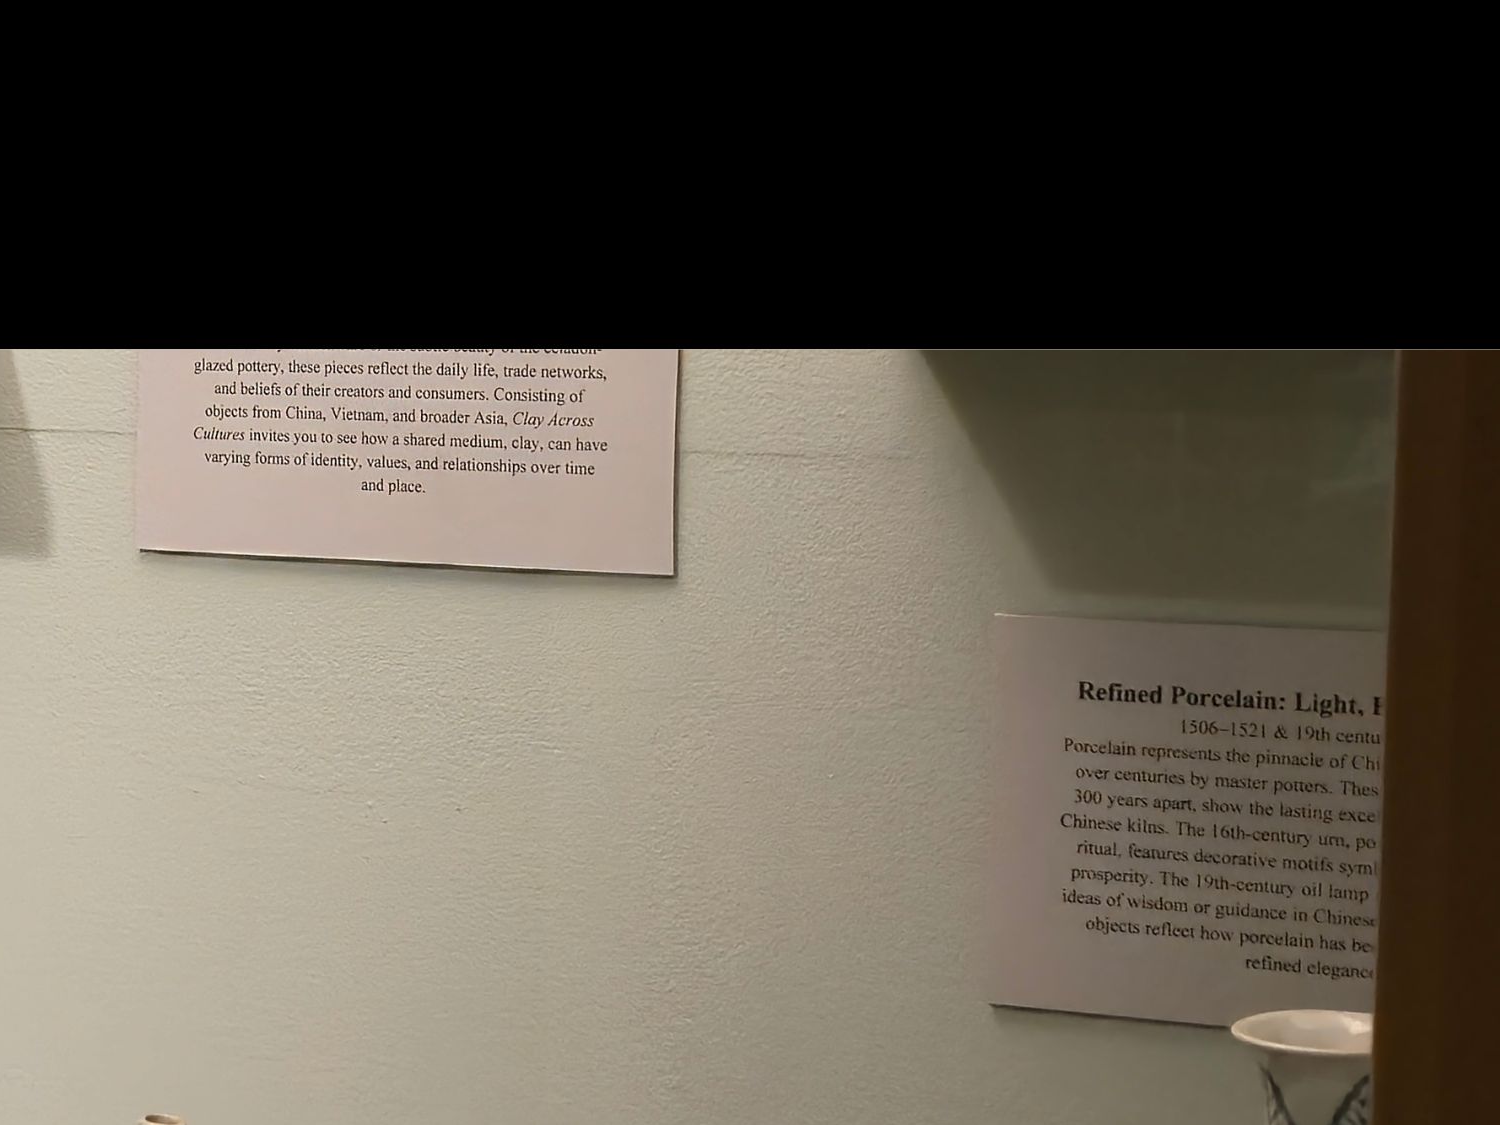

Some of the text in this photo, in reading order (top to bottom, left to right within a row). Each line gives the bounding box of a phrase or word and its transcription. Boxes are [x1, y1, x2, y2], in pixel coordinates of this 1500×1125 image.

[194, 358, 607, 382] glazed pottery, these pieces reflect the daily life, trade networks,
[214, 381, 586, 407] and beliefs of their creators and consumers. Consisting of
[205, 404, 594, 430] objects from China, Vietnam, and broader Asia, Clay Across
[193, 426, 608, 453] Cultures invites you to see how a shared medium, clay, can have
[204, 450, 595, 477] varying forms of identity, values, and relationships over time
[361, 478, 426, 496] and place.
[1079, 681, 1162, 704] Refined
[1172, 686, 1285, 710] Porcelain:
[1294, 692, 1364, 719] Light,
[1273, 725, 1289, 740] &
[1297, 725, 1330, 742] 19th
[1335, 732, 1380, 744] centu
[1064, 737, 1348, 769] Porcelain represents the pinnacle of
[1075, 767, 1333, 796] over centuries by master potters.
[1074, 788, 1334, 824] 300 years apart, show the lasting
[1060, 813, 1122, 832] Chinese
[1127, 817, 1169, 835] kilns.
[1176, 820, 1205, 837] The
[1213, 823, 1312, 848] 16th-century
[1077, 842, 1334, 872] ritual, features decorative motifs
[1071, 868, 1369, 905] prosperity. The 19th-century oil lamp
[1245, 955, 1373, 980] refined eleganc
